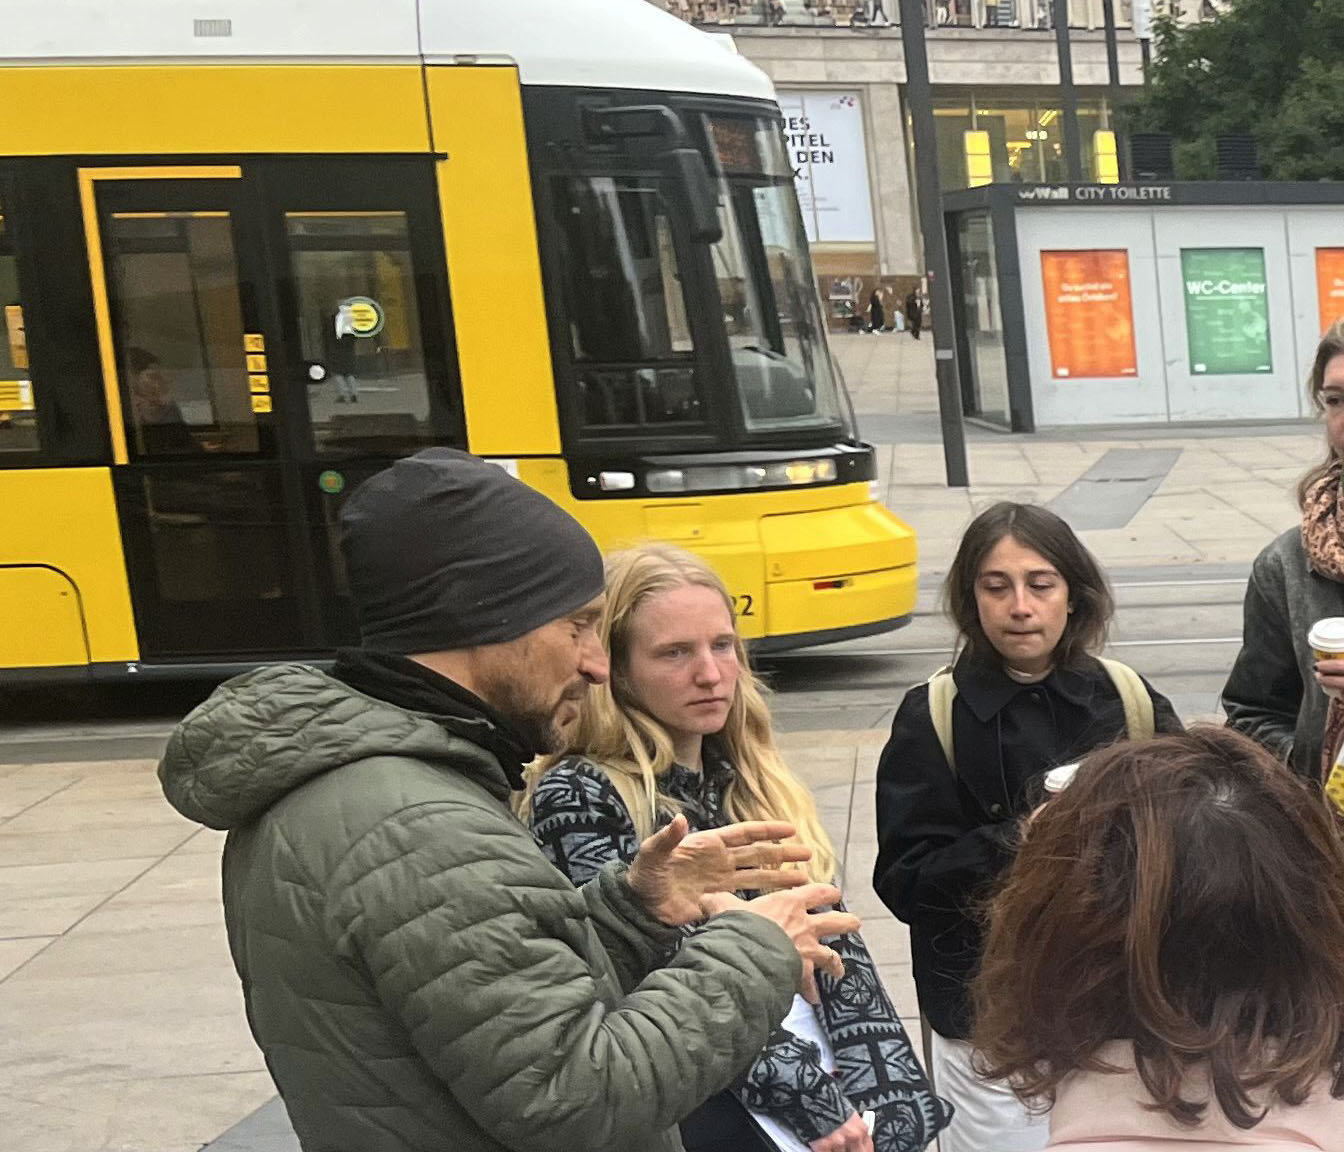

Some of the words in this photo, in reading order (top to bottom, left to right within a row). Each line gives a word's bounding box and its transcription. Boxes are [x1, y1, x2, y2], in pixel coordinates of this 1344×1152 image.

[797, 151, 834, 164] DEN
[1075, 187, 1105, 200] CITY
[1109, 186, 1171, 200] TOILETTE
[1185, 280, 1265, 295] WC-Center
